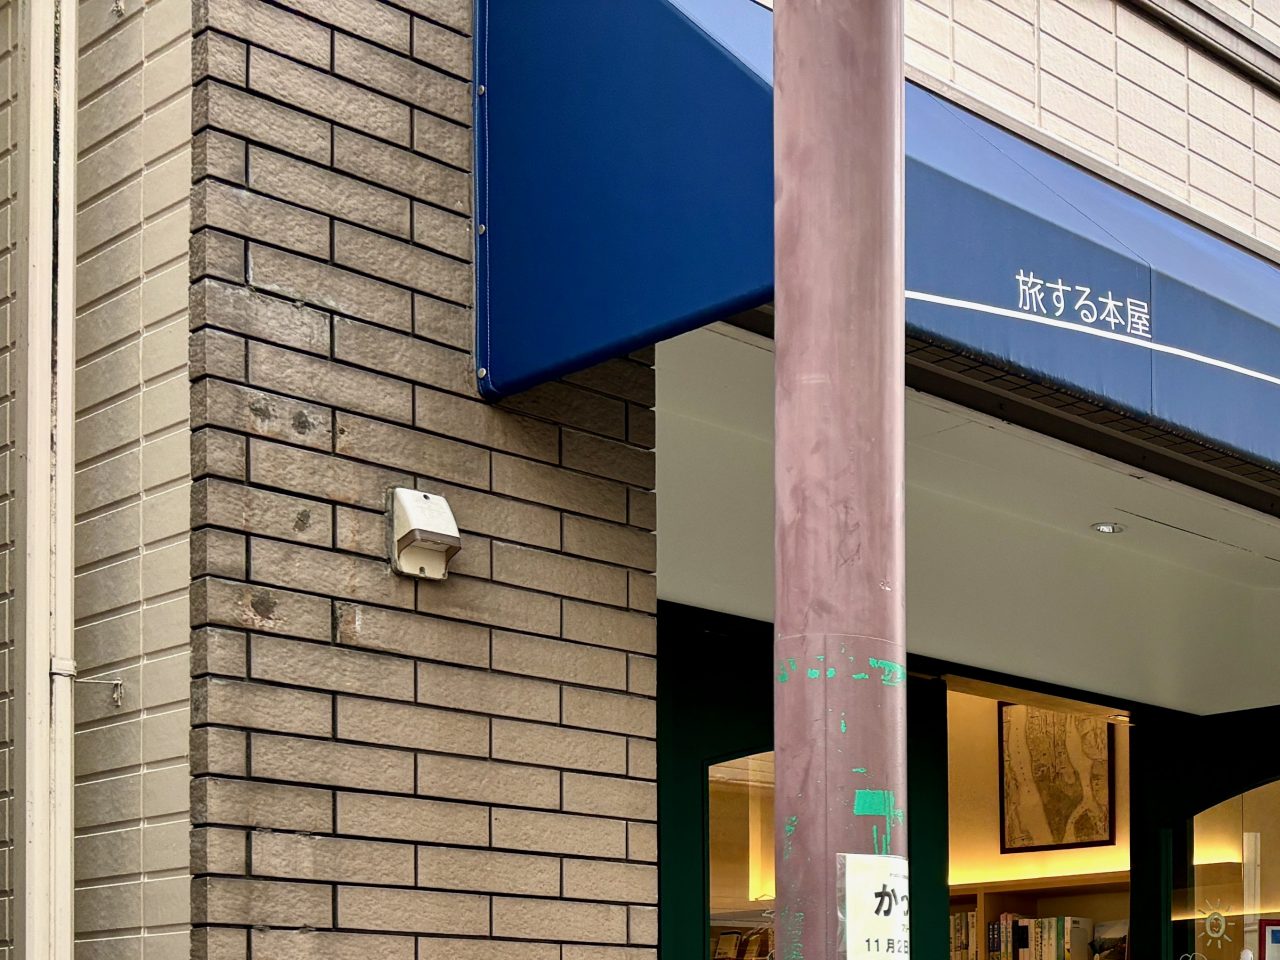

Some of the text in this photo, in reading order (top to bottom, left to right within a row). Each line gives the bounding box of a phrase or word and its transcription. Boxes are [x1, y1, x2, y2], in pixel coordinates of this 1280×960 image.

[1015, 268, 1152, 338] 旅する本屋
